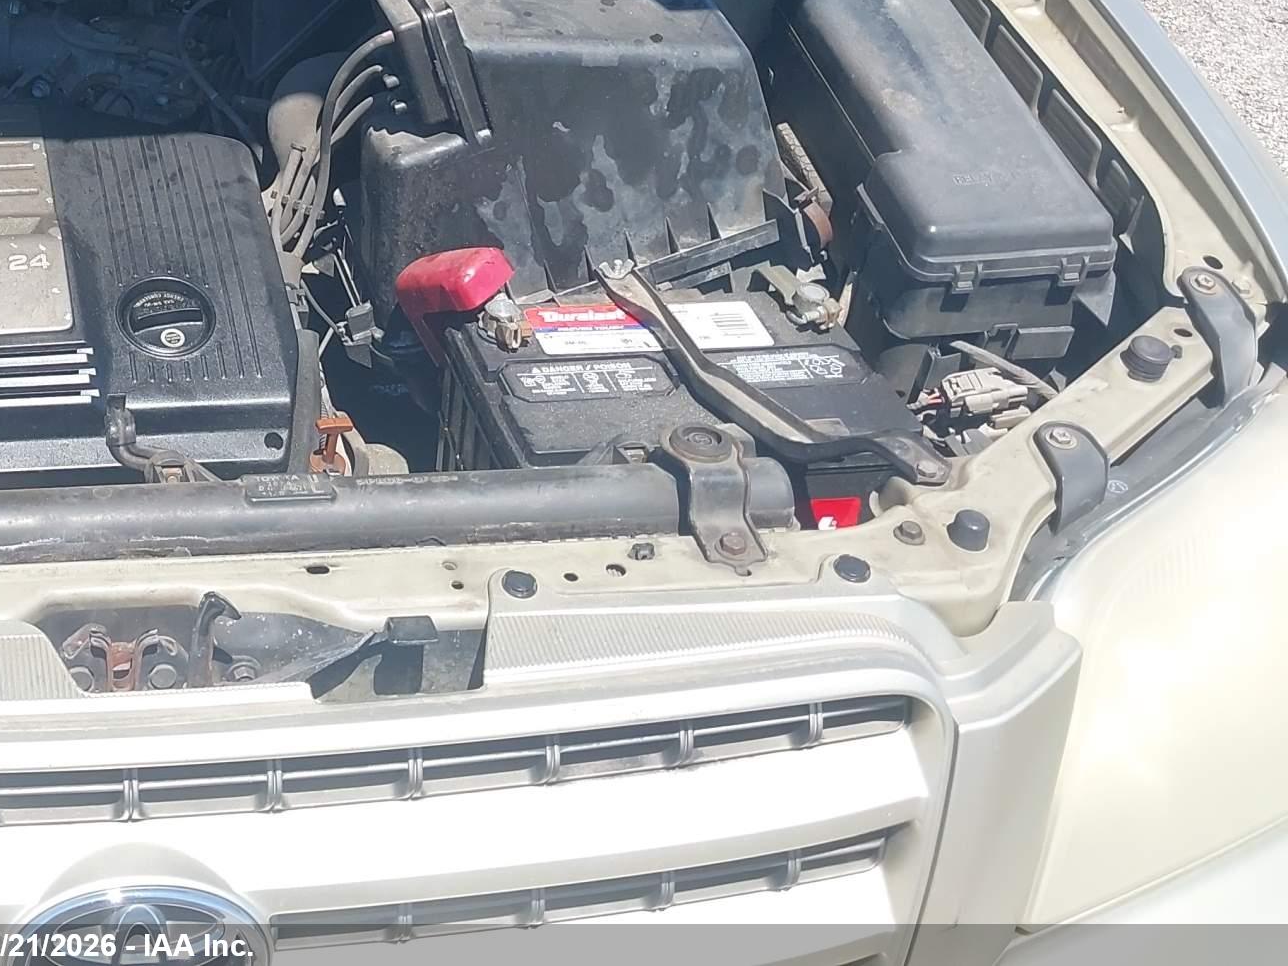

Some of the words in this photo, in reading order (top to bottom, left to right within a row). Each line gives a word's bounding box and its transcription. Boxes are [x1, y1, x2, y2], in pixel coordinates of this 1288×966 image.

[8, 252, 52, 272] 24
[537, 309, 626, 323] Duralast
[542, 364, 584, 373] DANGER
[593, 363, 632, 371] POISON
